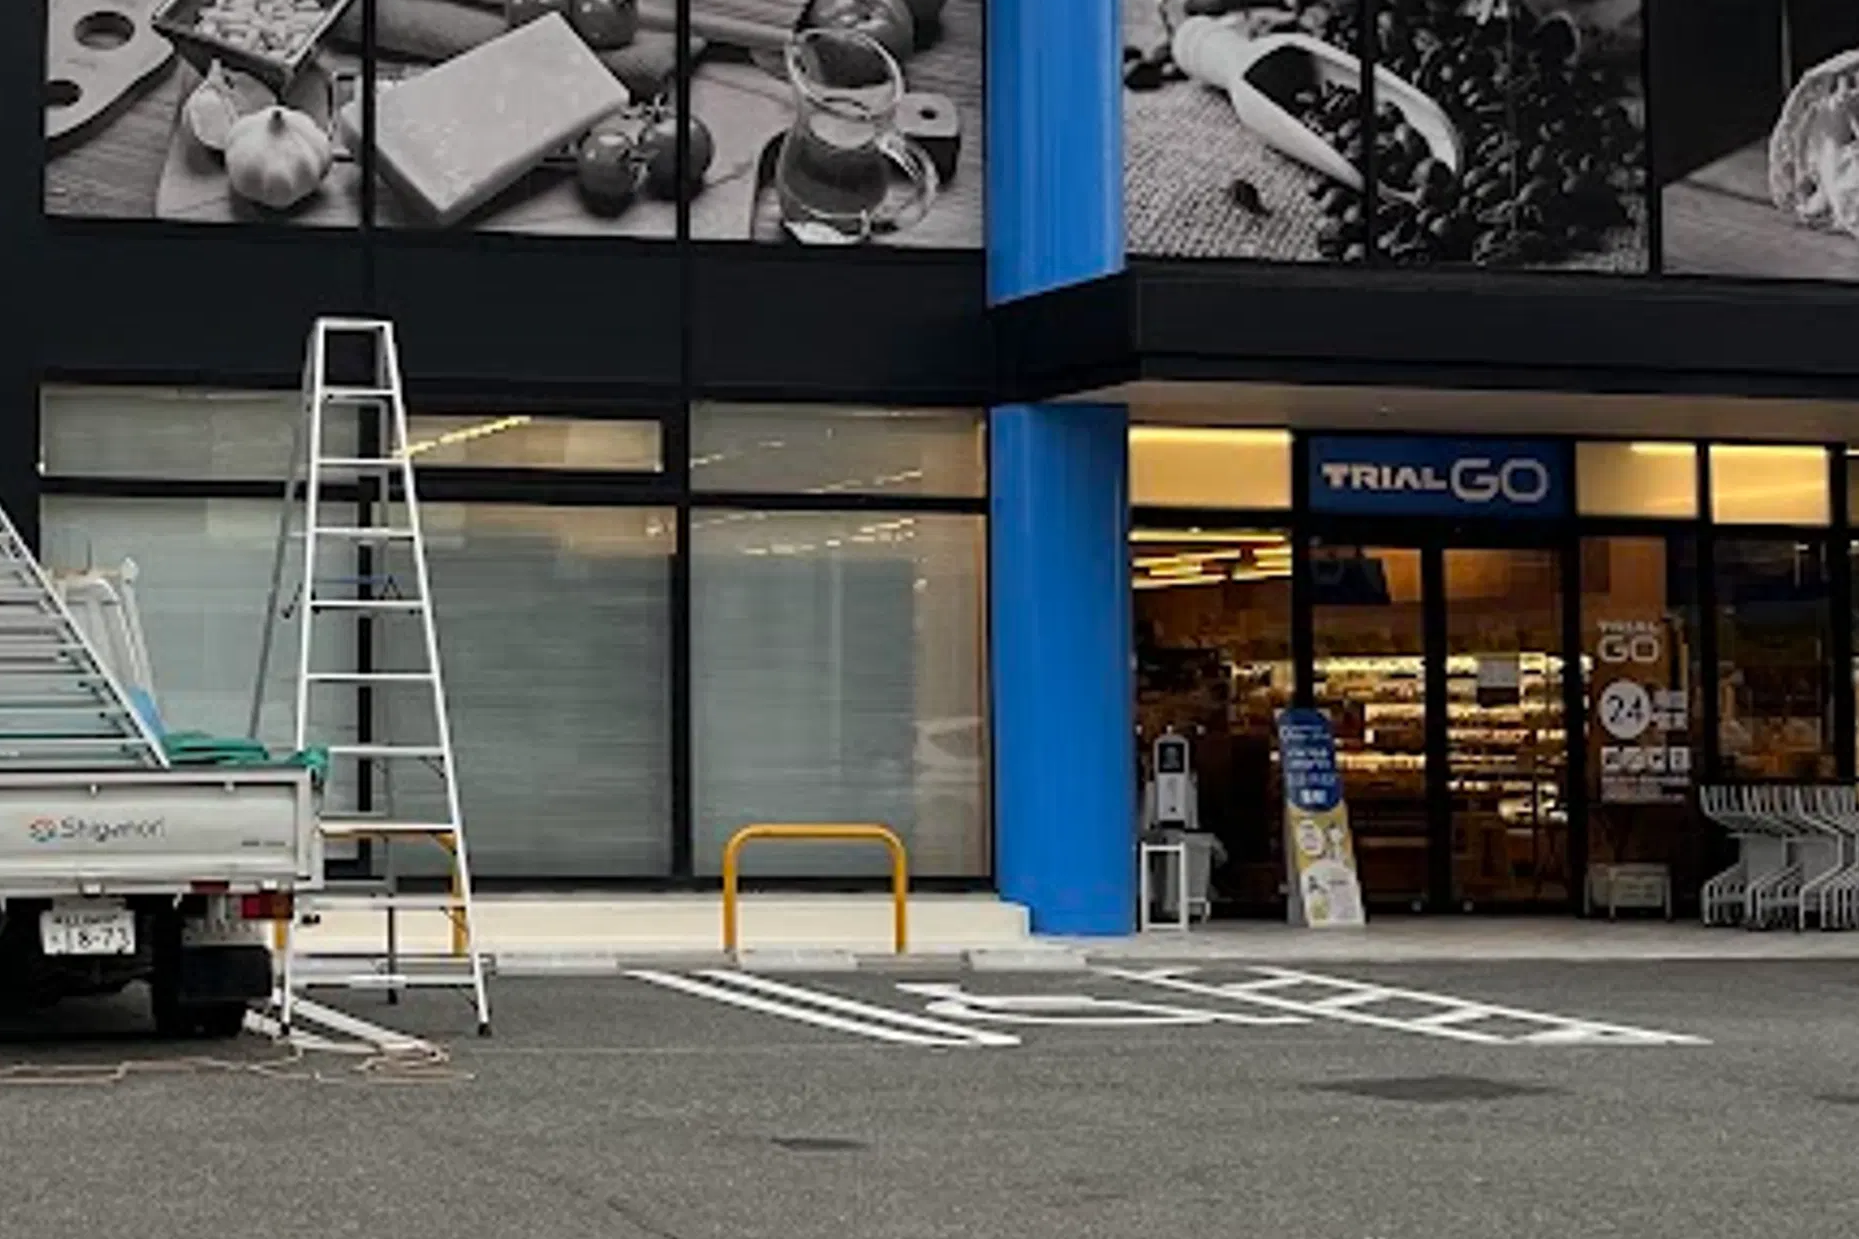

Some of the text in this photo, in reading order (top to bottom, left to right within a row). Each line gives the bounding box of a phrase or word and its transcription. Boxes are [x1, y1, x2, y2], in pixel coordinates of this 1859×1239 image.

[1321, 458, 1548, 503] TRIAL GO
[1598, 634, 1659, 662] GO
